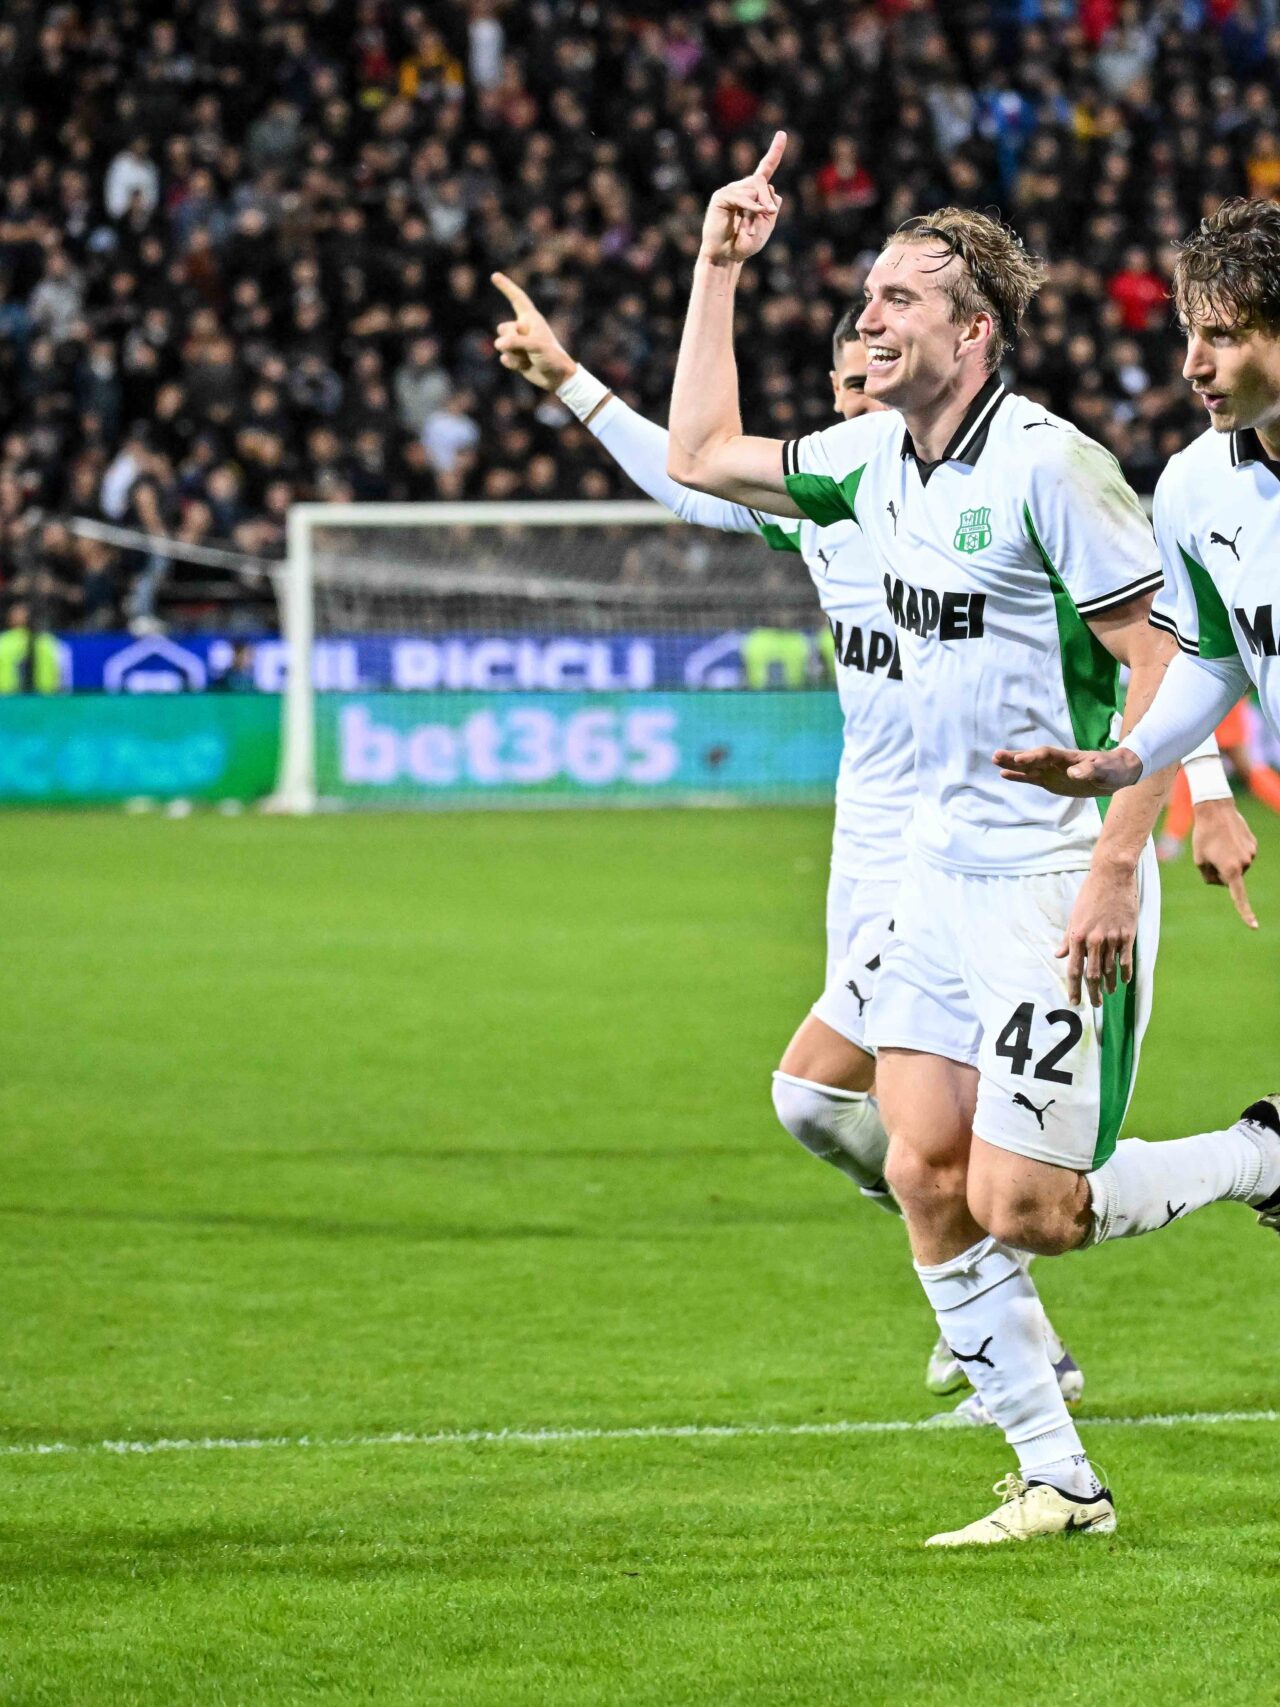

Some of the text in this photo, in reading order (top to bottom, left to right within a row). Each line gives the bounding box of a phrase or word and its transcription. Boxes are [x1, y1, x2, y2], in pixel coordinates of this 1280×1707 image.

[884, 572, 986, 641] MAPEI
[339, 703, 679, 785] bet365
[995, 1002, 1082, 1085] 42
